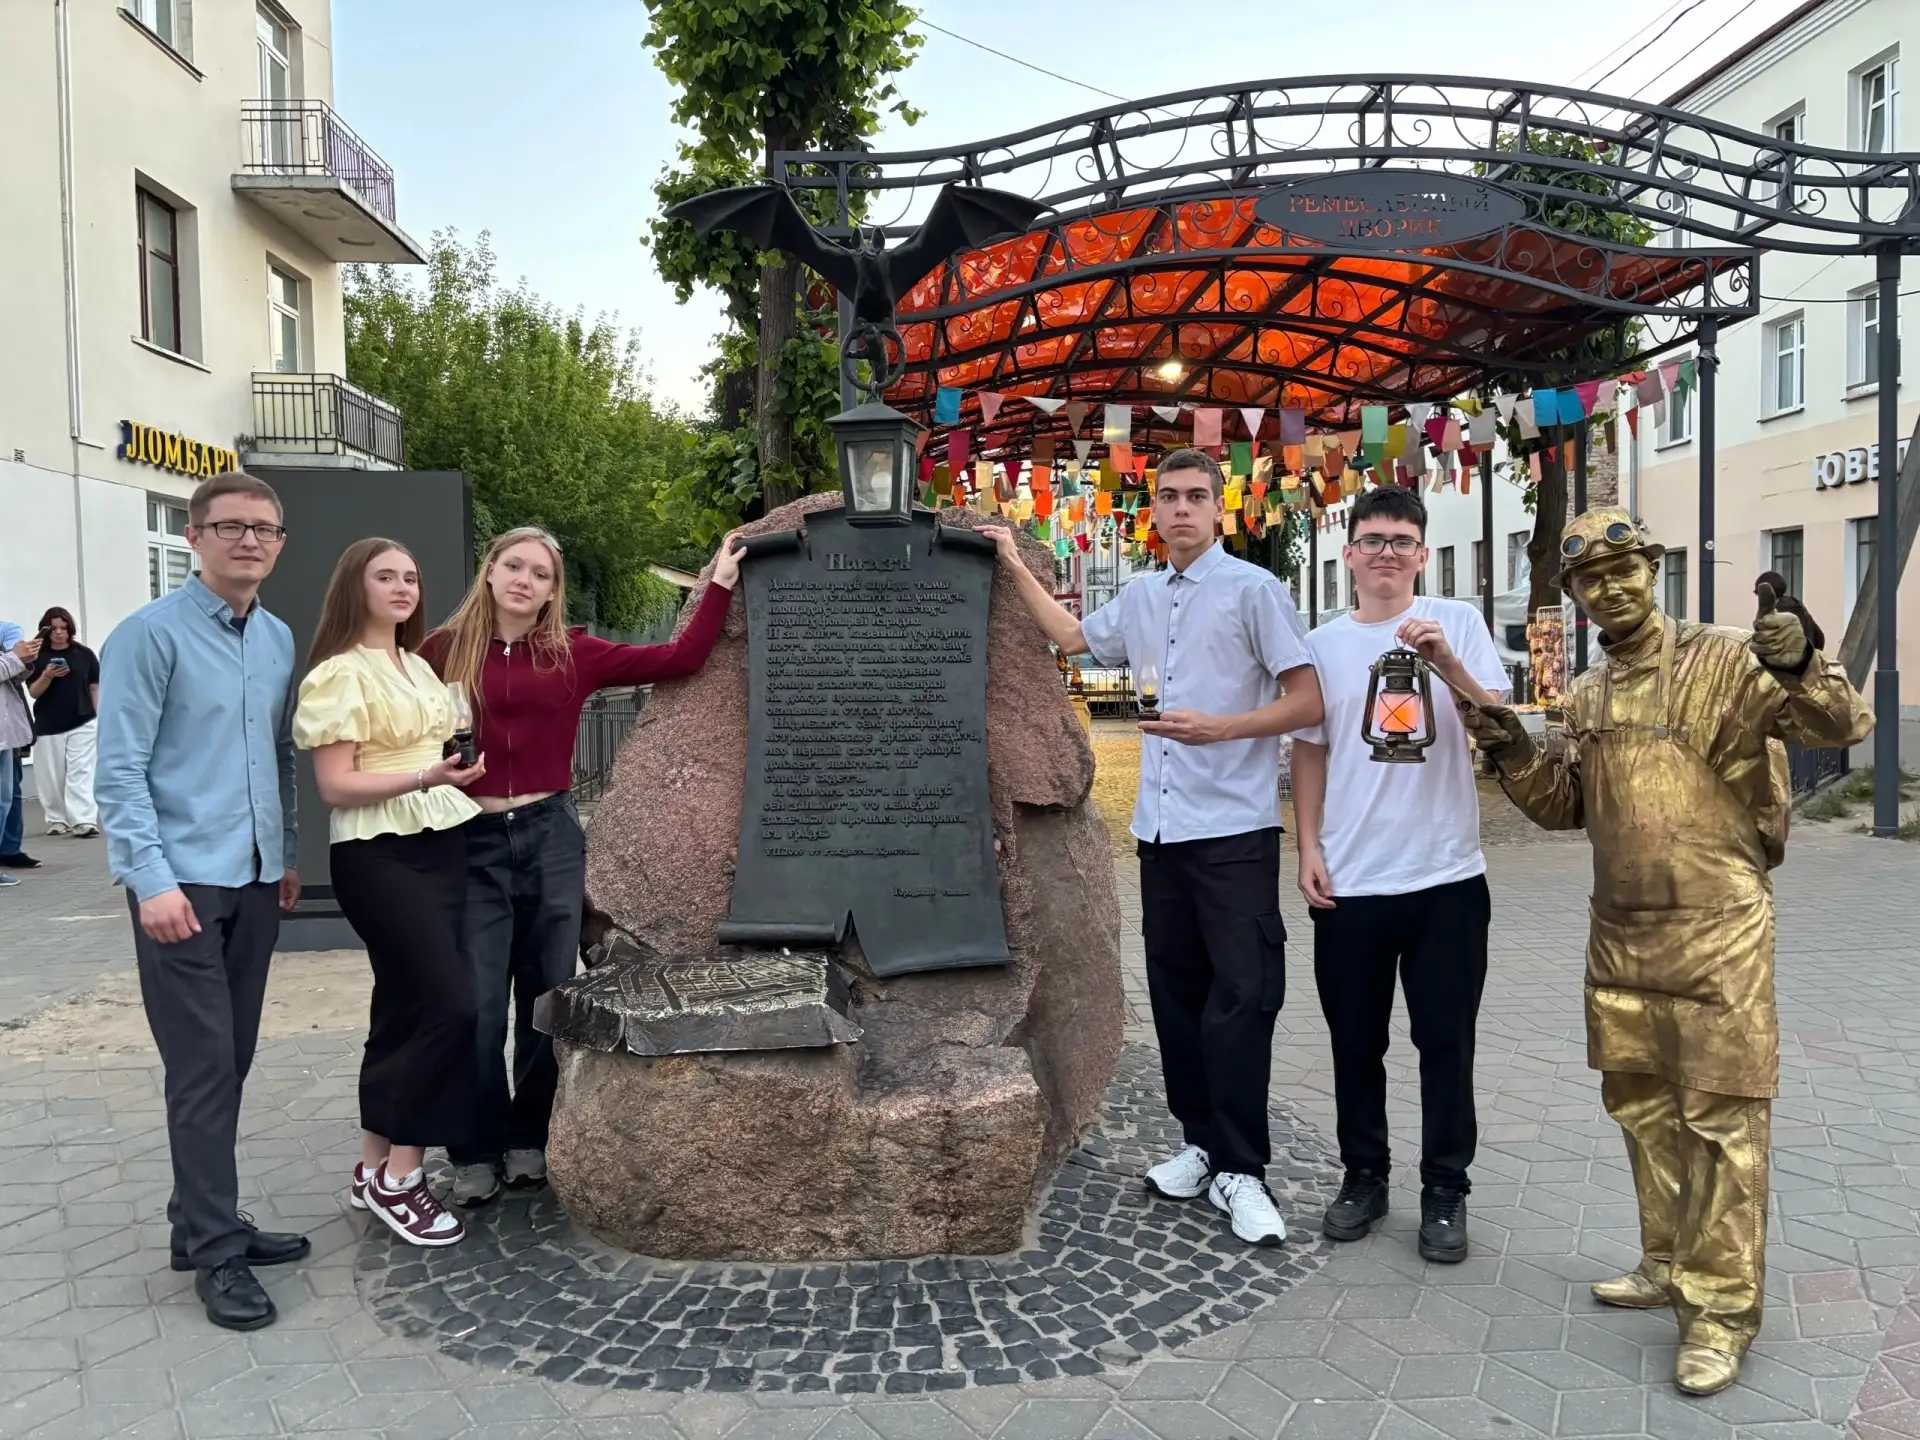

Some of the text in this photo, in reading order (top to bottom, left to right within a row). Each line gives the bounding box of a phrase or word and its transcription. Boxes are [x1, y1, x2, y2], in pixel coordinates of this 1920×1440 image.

[1289, 188, 1489, 212] РЕМЕСЛЕННЫЙ
[1337, 218, 1444, 240] ДВОРИК
[768, 593, 784, 605] не
[896, 593, 911, 605] на
